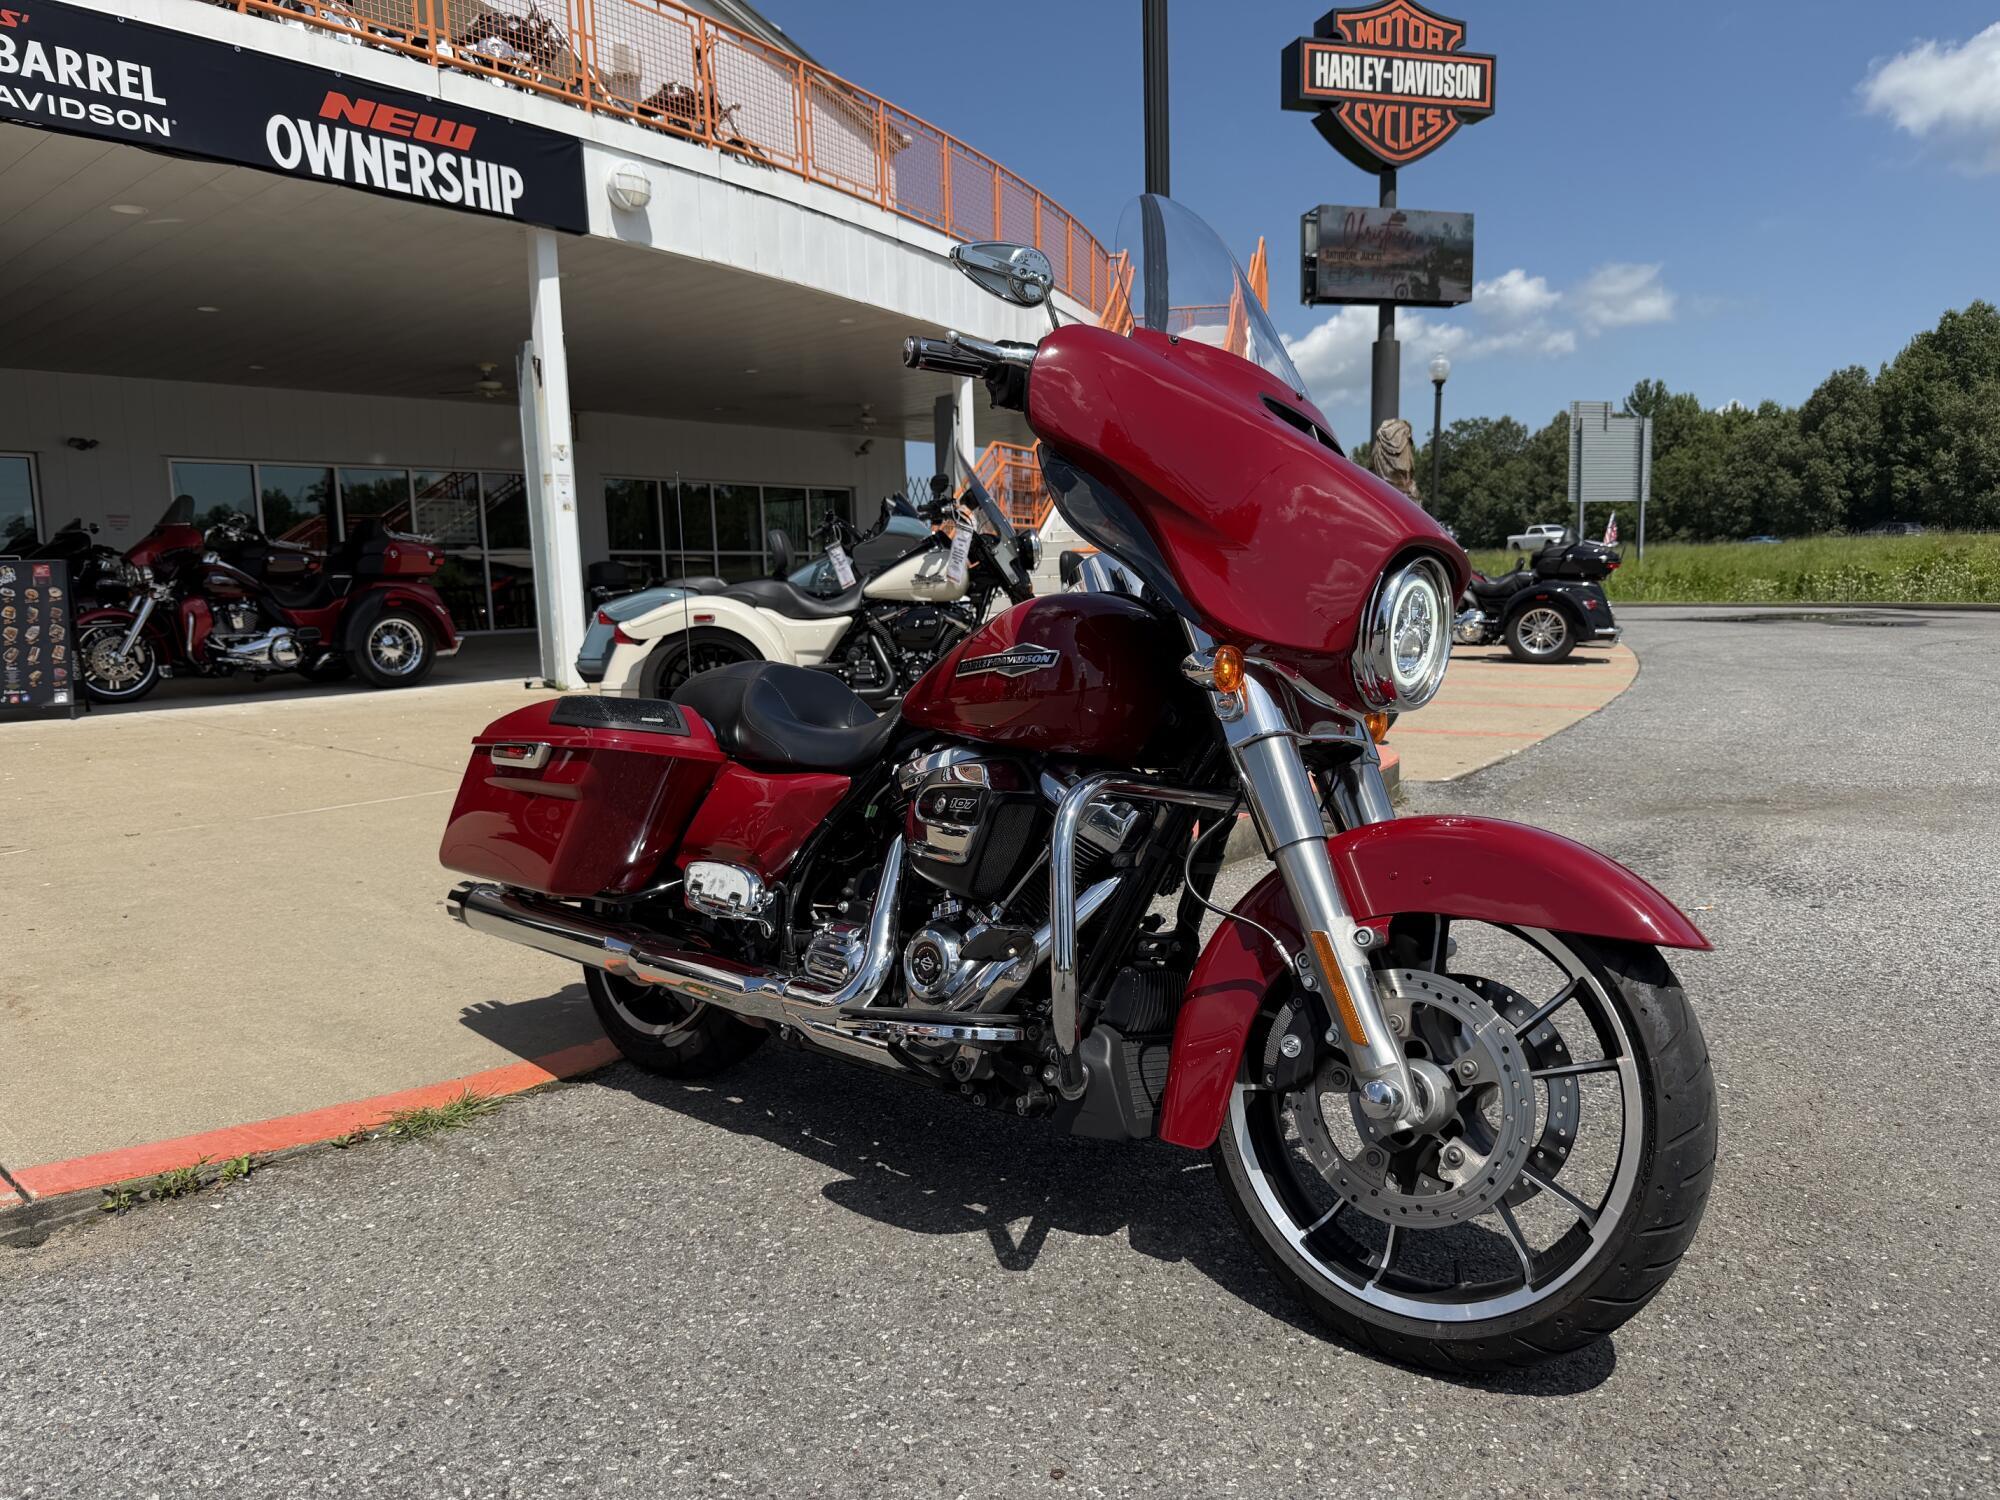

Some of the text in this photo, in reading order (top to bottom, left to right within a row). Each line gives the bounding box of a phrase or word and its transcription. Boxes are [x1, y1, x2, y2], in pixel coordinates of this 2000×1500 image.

[1356, 9, 1443, 51] MOTOR
[0, 33, 166, 106] BARREL
[1315, 52, 1481, 100] HARLEY-DAVIDSON
[319, 91, 477, 151] NEW
[1355, 103, 1442, 150] CYCLES
[266, 114, 524, 216] OWNERSHIP
[949, 797, 977, 810] 107
